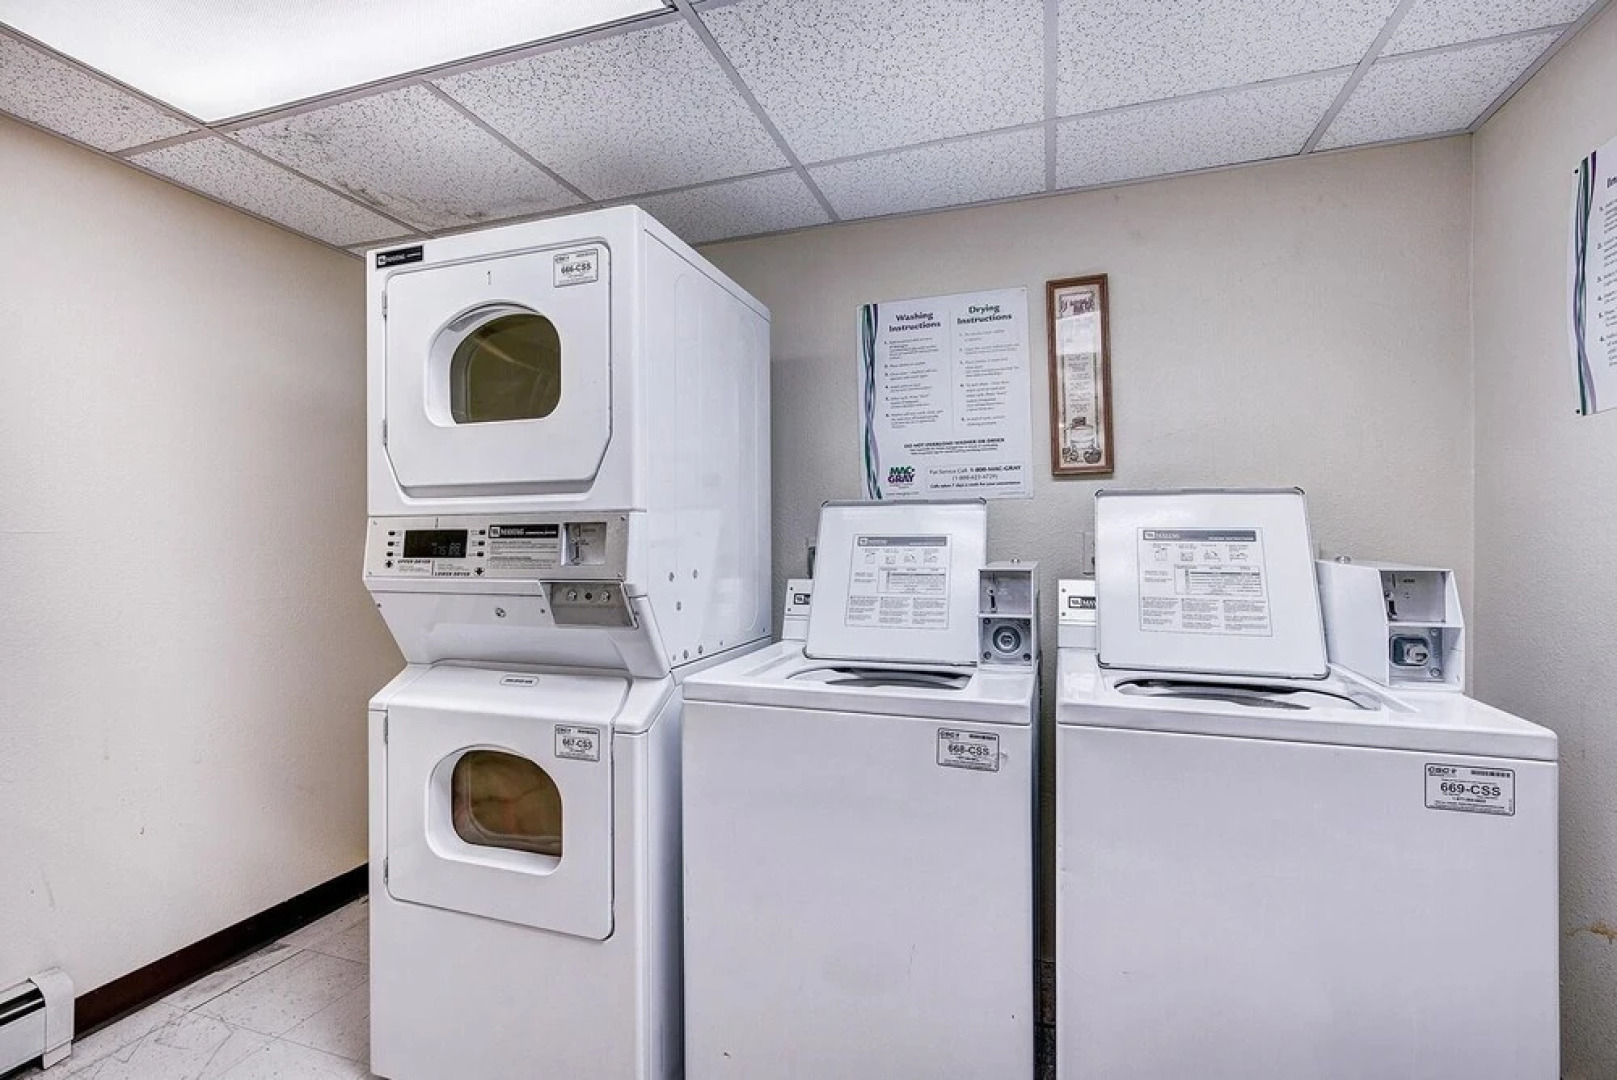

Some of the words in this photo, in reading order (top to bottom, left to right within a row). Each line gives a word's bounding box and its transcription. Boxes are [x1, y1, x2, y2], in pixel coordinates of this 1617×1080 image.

[968, 303, 1001, 314] Drying
[895, 312, 934, 321] Washing
[956, 313, 1013, 325] Instructions
[888, 321, 942, 332] Instructions
[887, 474, 916, 483] GRAY
[1440, 782, 1501, 797] 669-CSS
